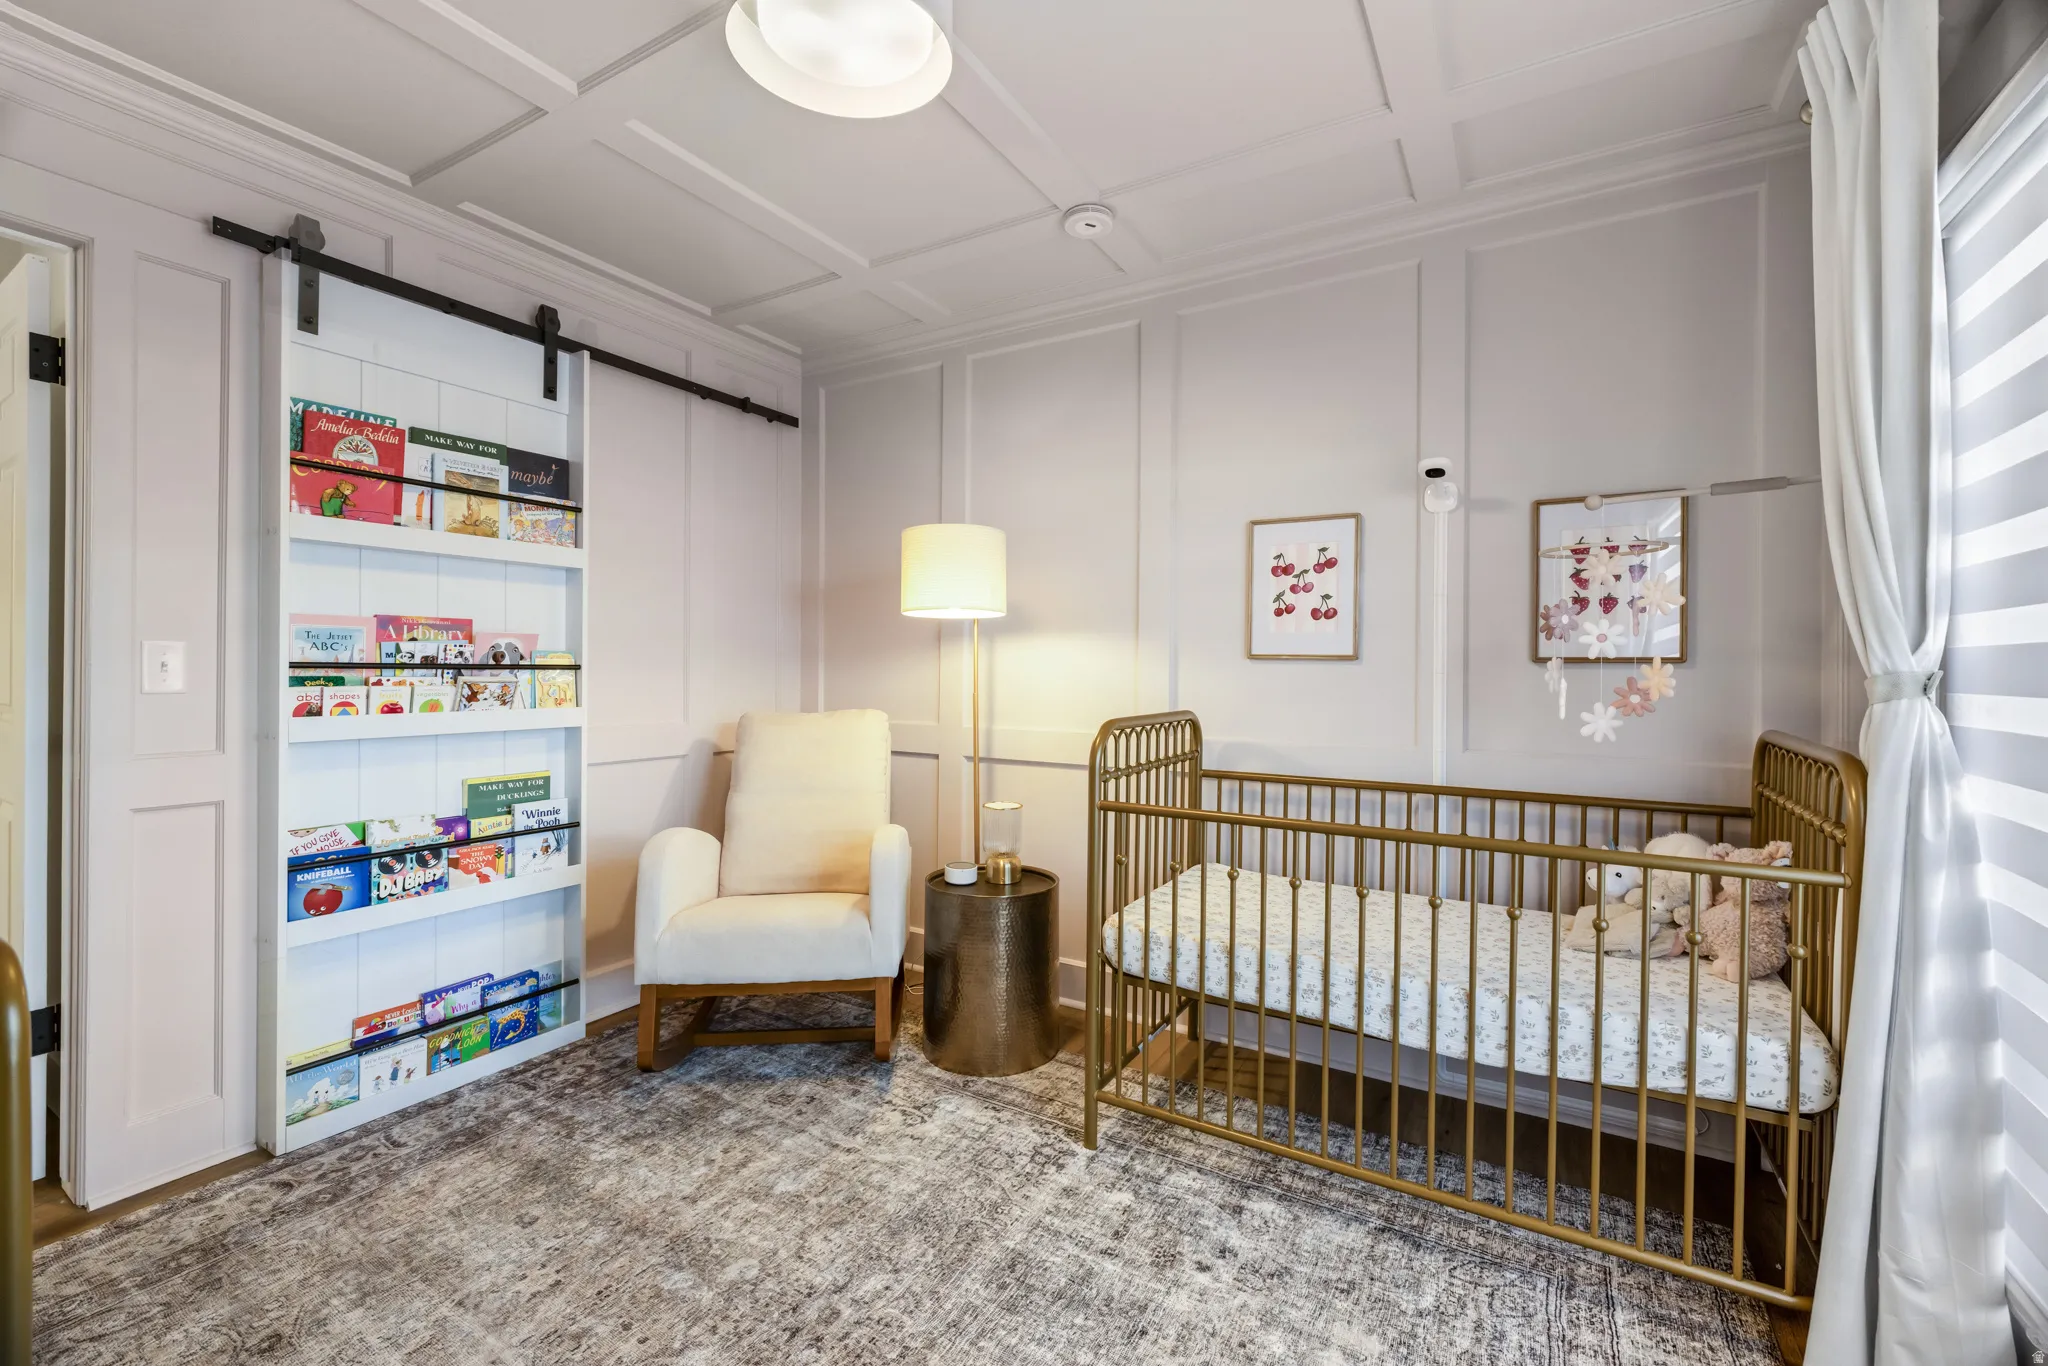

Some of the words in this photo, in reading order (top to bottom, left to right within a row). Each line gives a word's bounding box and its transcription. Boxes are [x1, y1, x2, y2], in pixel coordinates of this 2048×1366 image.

[310, 418, 354, 436] Amelia
[355, 426, 400, 445] Bedelia
[425, 434, 453, 446] MAKE
[456, 440, 476, 450] WAY
[479, 445, 498, 454] FOR
[510, 470, 554, 488] maybe
[384, 625, 397, 639] A
[402, 624, 467, 641] Library
[296, 693, 321, 702] abc
[329, 693, 361, 701] shapes
[479, 783, 505, 792] MAKE
[507, 780, 526, 789] WAY
[496, 789, 545, 801] DUCKLINGS
[521, 807, 561, 820] Winnie
[477, 820, 503, 836] Auntie
[535, 817, 561, 829] Pooh
[289, 845, 300, 856] IF
[301, 838, 318, 852] YOU
[318, 828, 341, 843] GIVE
[460, 854, 494, 866] SNOWY
[468, 861, 487, 871] DAY
[296, 866, 352, 882] KNIFEBALL
[378, 875, 404, 900] DJ
[404, 868, 445, 892] BABY
[451, 1003, 469, 1014] Why
[457, 1035, 484, 1050] LOON
[322, 1058, 357, 1074] World
